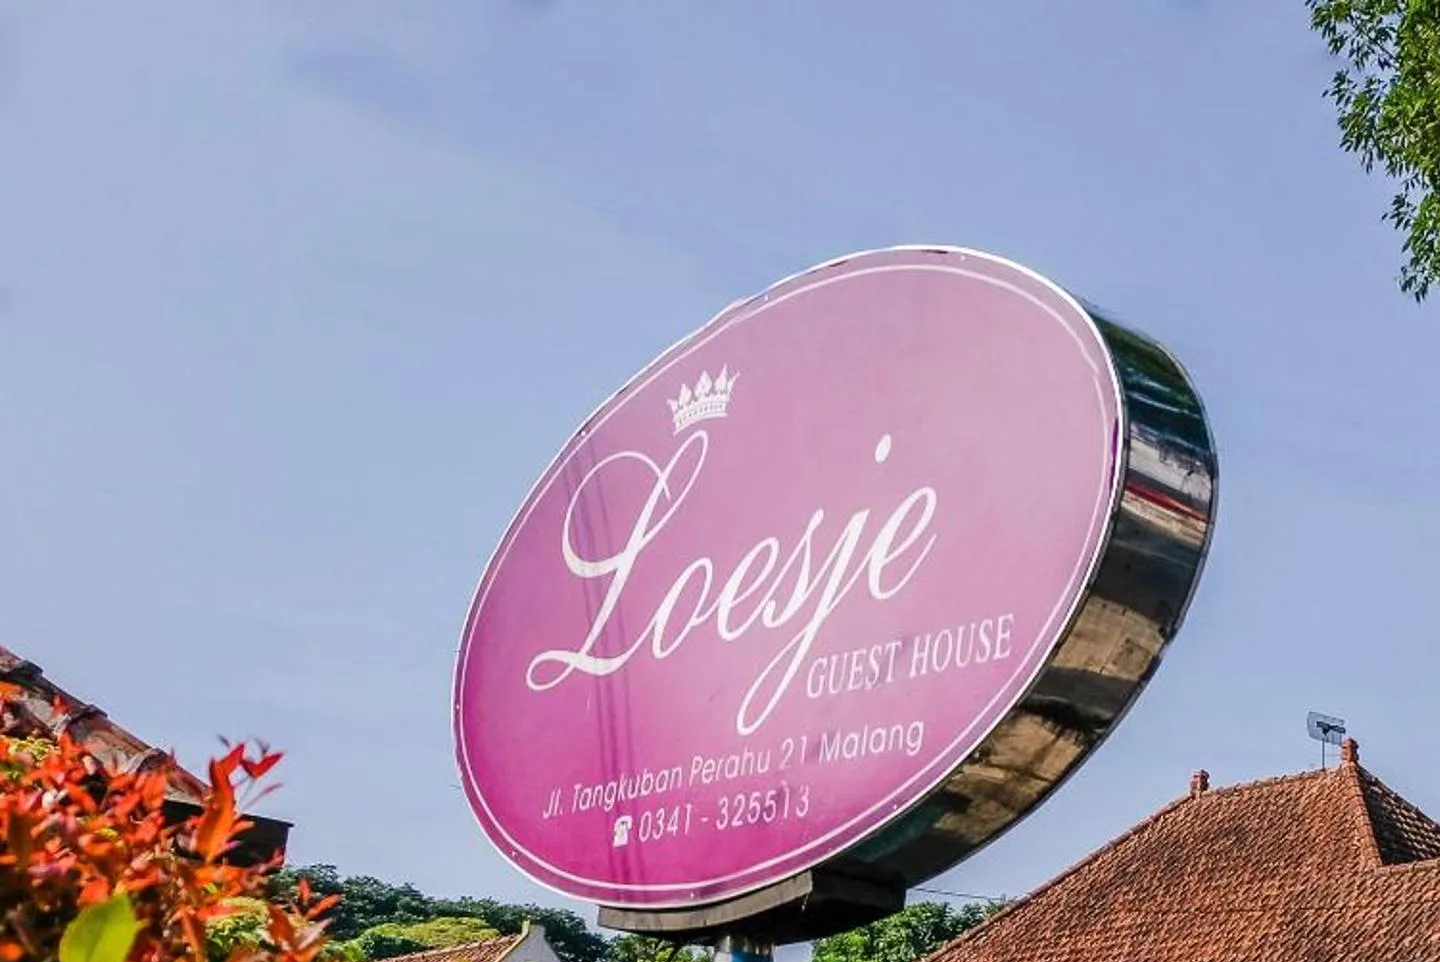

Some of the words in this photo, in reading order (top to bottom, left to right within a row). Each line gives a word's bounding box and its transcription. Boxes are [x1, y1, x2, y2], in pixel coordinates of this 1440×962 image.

[525, 430, 938, 736] Loesje
[805, 639, 902, 699] GUEST
[908, 612, 1015, 678] HOUSE
[541, 790, 565, 819] Jl.
[571, 765, 684, 813] Tangkuban
[688, 747, 772, 785] Perahu
[778, 734, 808, 771] 21
[818, 720, 925, 765] Malang
[637, 802, 694, 844] 0341
[715, 779, 811, 830] 325513
